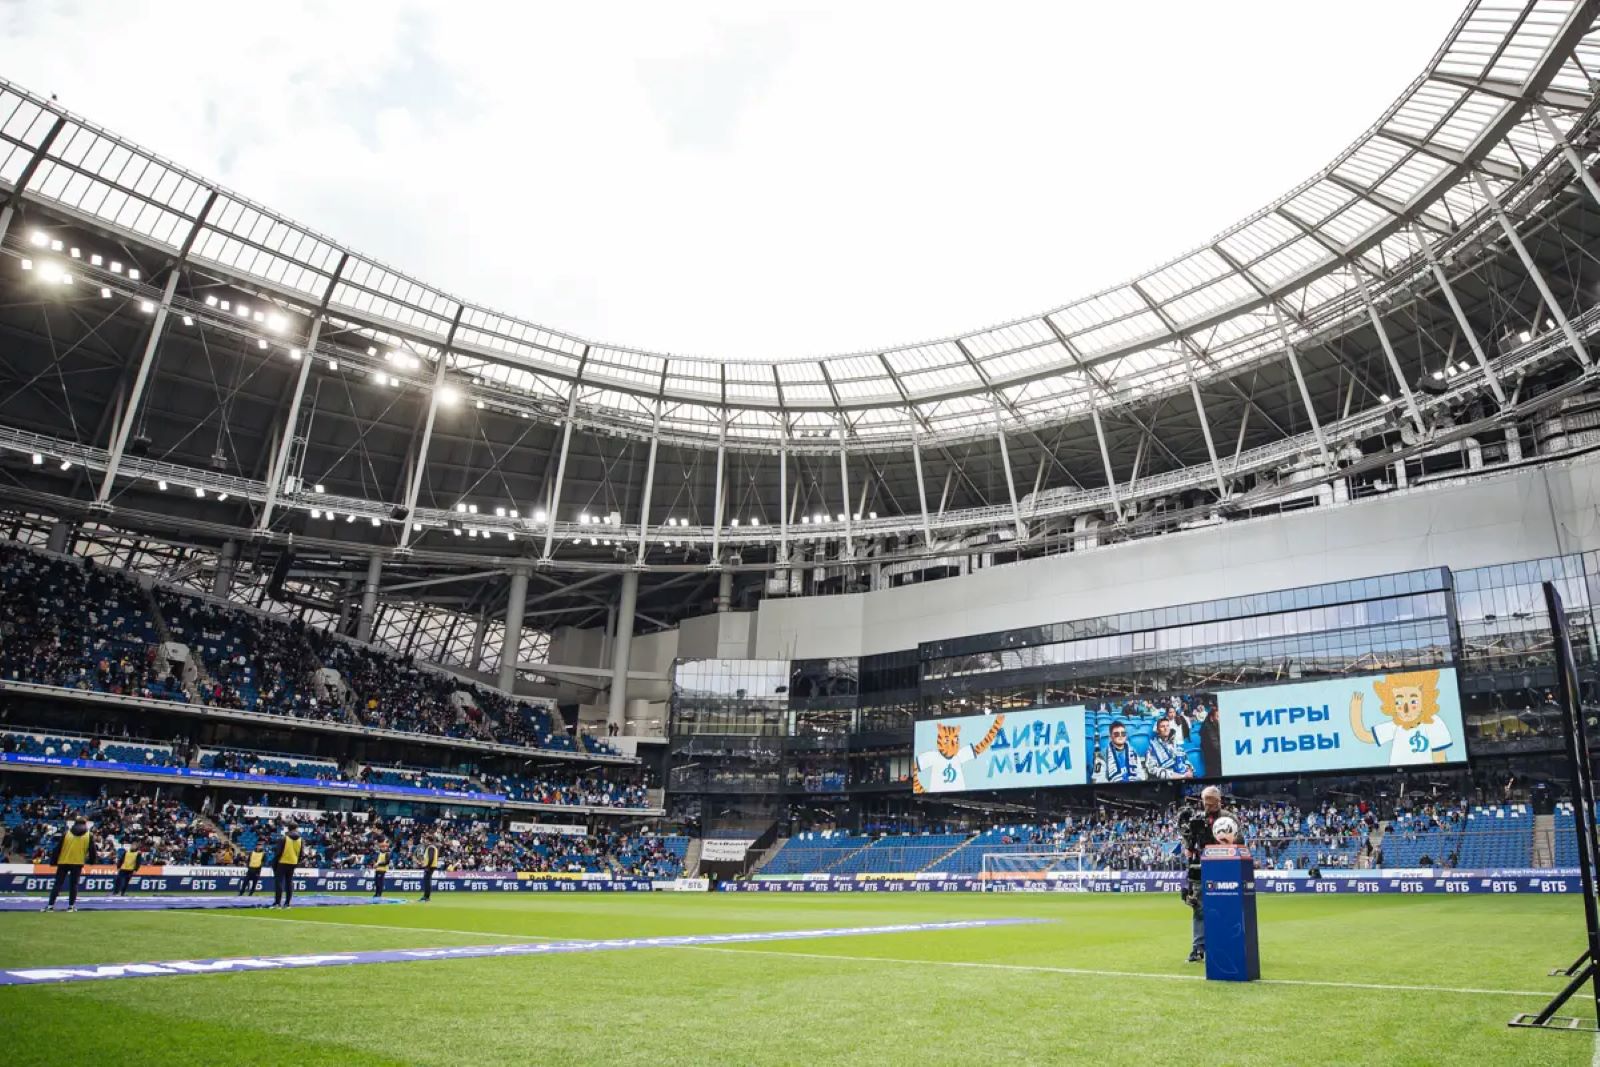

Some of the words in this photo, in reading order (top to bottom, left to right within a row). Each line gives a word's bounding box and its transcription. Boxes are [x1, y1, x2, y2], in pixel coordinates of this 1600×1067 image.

[1239, 704, 1330, 727] ТИГРЫ
[991, 720, 1070, 750] ДИНА
[1235, 739, 1253, 755] И
[1261, 732, 1341, 754] ЛЬВЫ
[988, 747, 1072, 778] МИКИ
[86, 879, 114, 890] ВТБ
[141, 879, 167, 890] ВТБ
[192, 879, 216, 890] ВТБ
[327, 880, 347, 890] ВТБ
[403, 881, 421, 890] ВТБ
[438, 881, 456, 890] ВТБ
[471, 882, 488, 890] ВТБ
[503, 882, 519, 890] ВТБ
[532, 882, 548, 890] ВТБ
[561, 882, 576, 890] ВТБ
[588, 882, 602, 890] ВТБ
[613, 882, 627, 890] ВТБ
[687, 881, 702, 889] ВТБ
[864, 883, 878, 891] ВТБ
[916, 882, 930, 891] ВТБ
[943, 882, 958, 891] ВТБ
[1095, 882, 1111, 891] ВТБ
[1163, 882, 1182, 891] ВТБ
[1275, 882, 1296, 892] ВТБ
[1316, 882, 1336, 892] ВТБ
[1357, 882, 1379, 892] ВТБ
[1401, 882, 1423, 892] ВТБ
[1445, 881, 1470, 892] ВТБ
[1492, 880, 1518, 892] ВТБ
[1541, 880, 1567, 892] ВТБ
[1217, 882, 1239, 890] МИР
